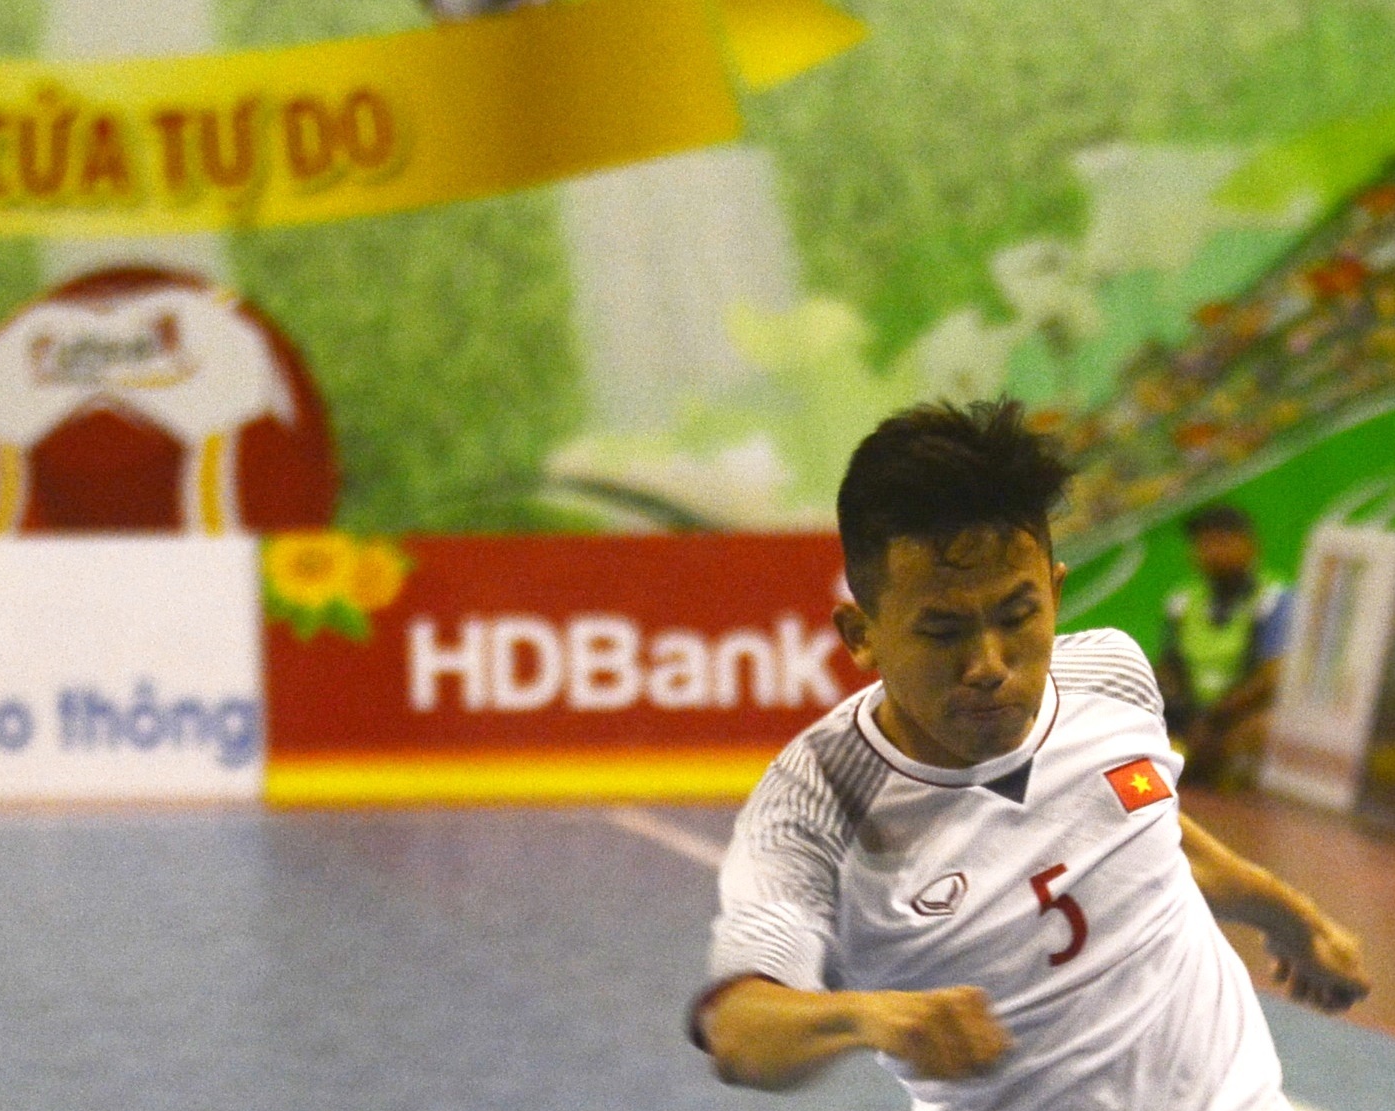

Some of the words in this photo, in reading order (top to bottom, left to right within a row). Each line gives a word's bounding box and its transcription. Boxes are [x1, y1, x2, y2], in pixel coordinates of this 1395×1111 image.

[280, 83, 395, 181] DO
[407, 613, 845, 712] HDBank
[1030, 862, 1089, 967] 5
